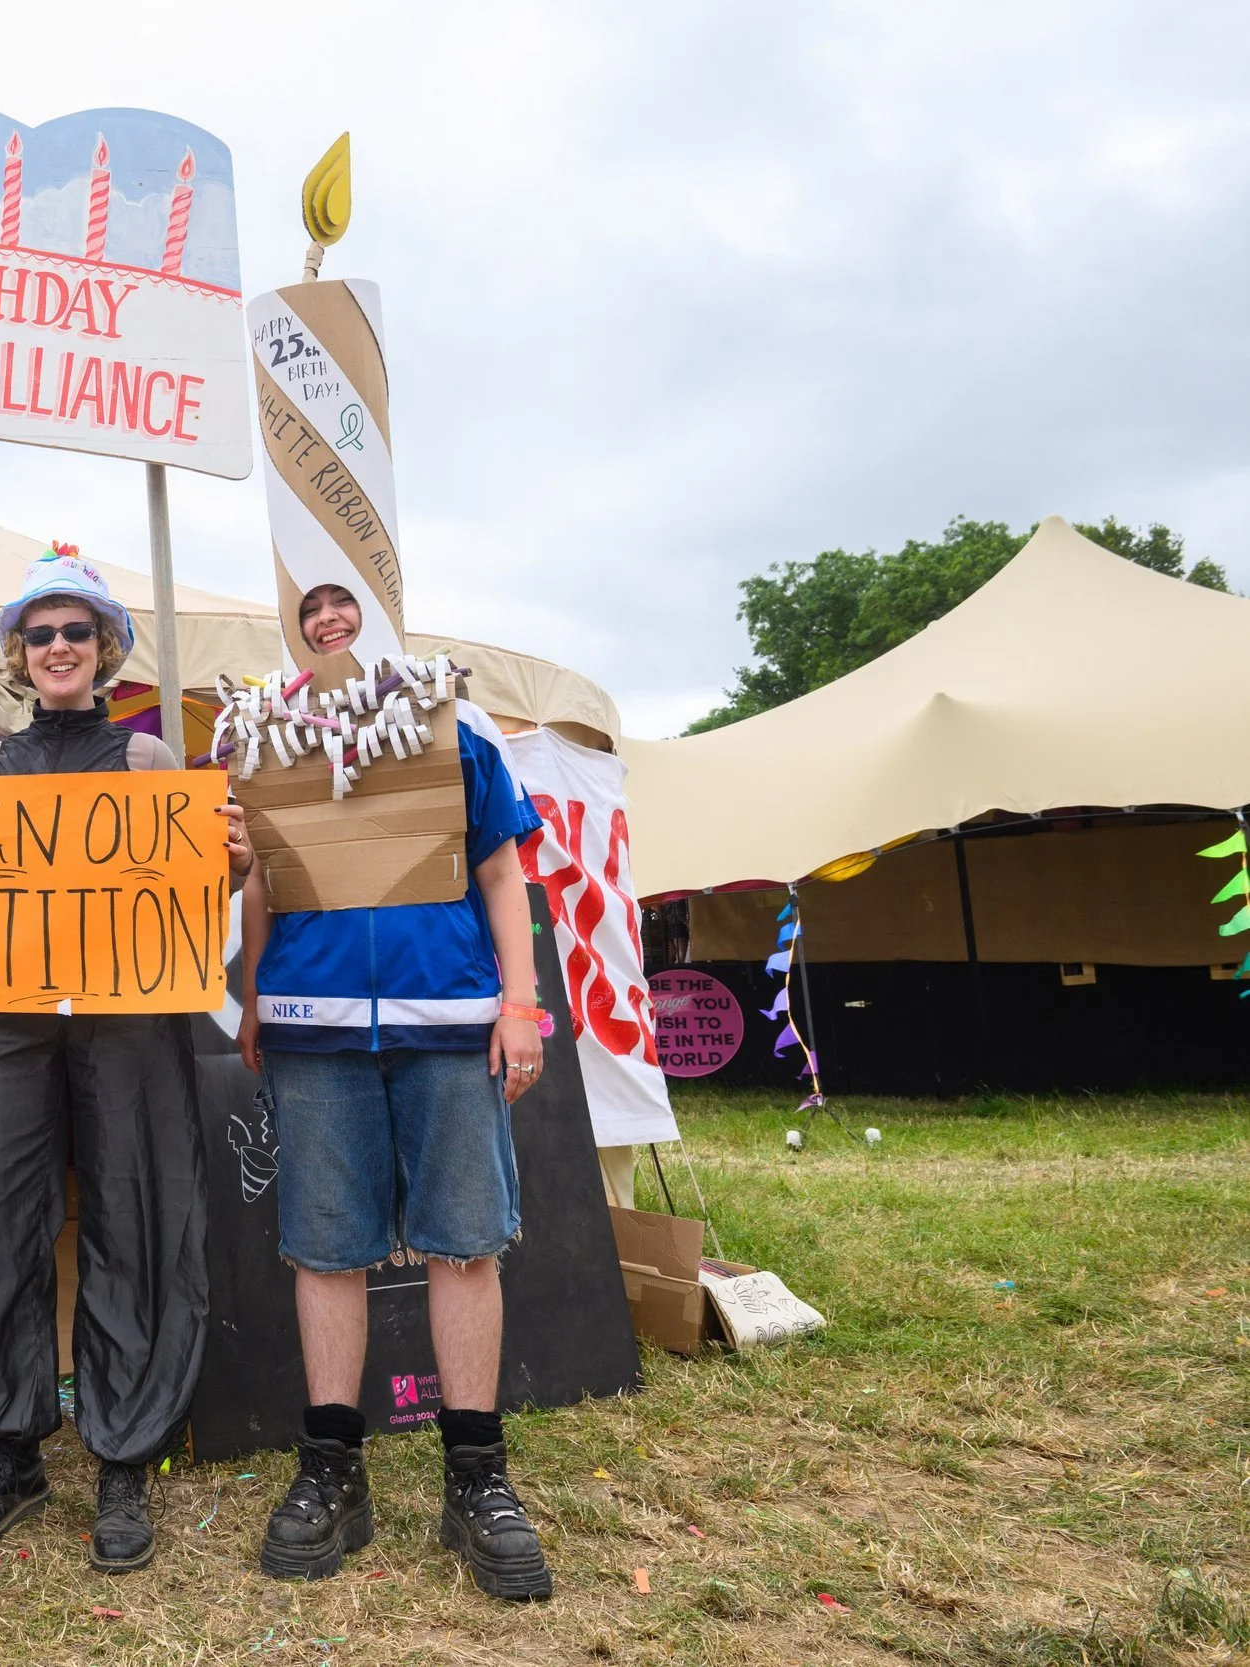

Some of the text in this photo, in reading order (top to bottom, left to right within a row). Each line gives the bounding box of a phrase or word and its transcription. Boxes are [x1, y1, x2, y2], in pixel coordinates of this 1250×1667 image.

[254, 315, 293, 347] HAPPY
[269, 332, 320, 368] 25th
[288, 361, 328, 381] BIRTH
[303, 382, 339, 401] DAY!
[259, 383, 321, 468] WHITE
[310, 461, 378, 542] RIBBON
[85, 791, 204, 865] OUR
[650, 979, 714, 992] BE THE
[271, 1003, 314, 1019] NIKE
[693, 998, 730, 1011] YOU
[657, 1017, 722, 1030] ISH TO
[675, 1034, 694, 1048] IN
[698, 1033, 735, 1046] THE
[658, 1052, 723, 1067] WORLD
[417, 1374, 440, 1386] WHIT
[389, 1412, 415, 1424] Glasto
[416, 1410, 436, 1421] 2024
